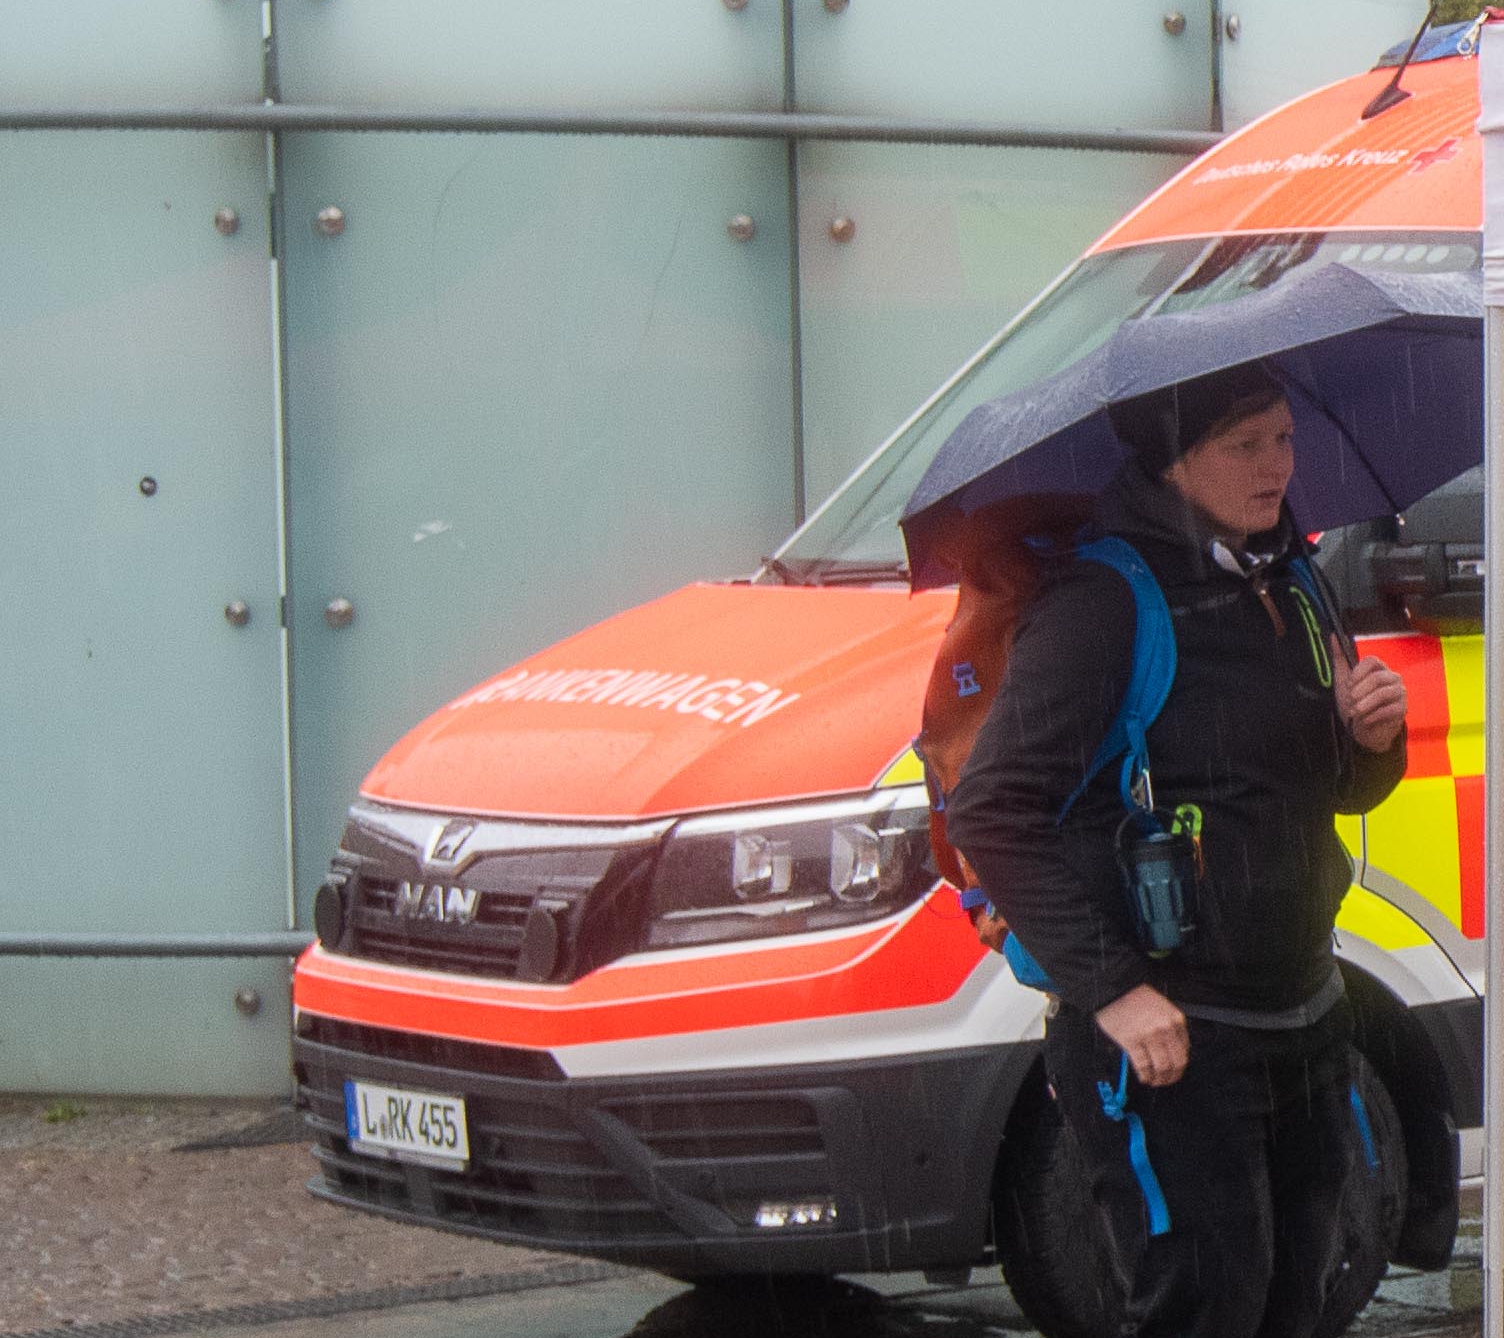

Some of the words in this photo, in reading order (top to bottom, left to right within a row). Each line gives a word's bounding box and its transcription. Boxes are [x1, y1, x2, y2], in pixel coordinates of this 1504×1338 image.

[1338, 147, 1410, 168] Kreuz
[394, 880, 481, 926] MAN
[361, 1091, 378, 1136] L
[386, 1095, 415, 1143] RK
[417, 1100, 459, 1150] 455
